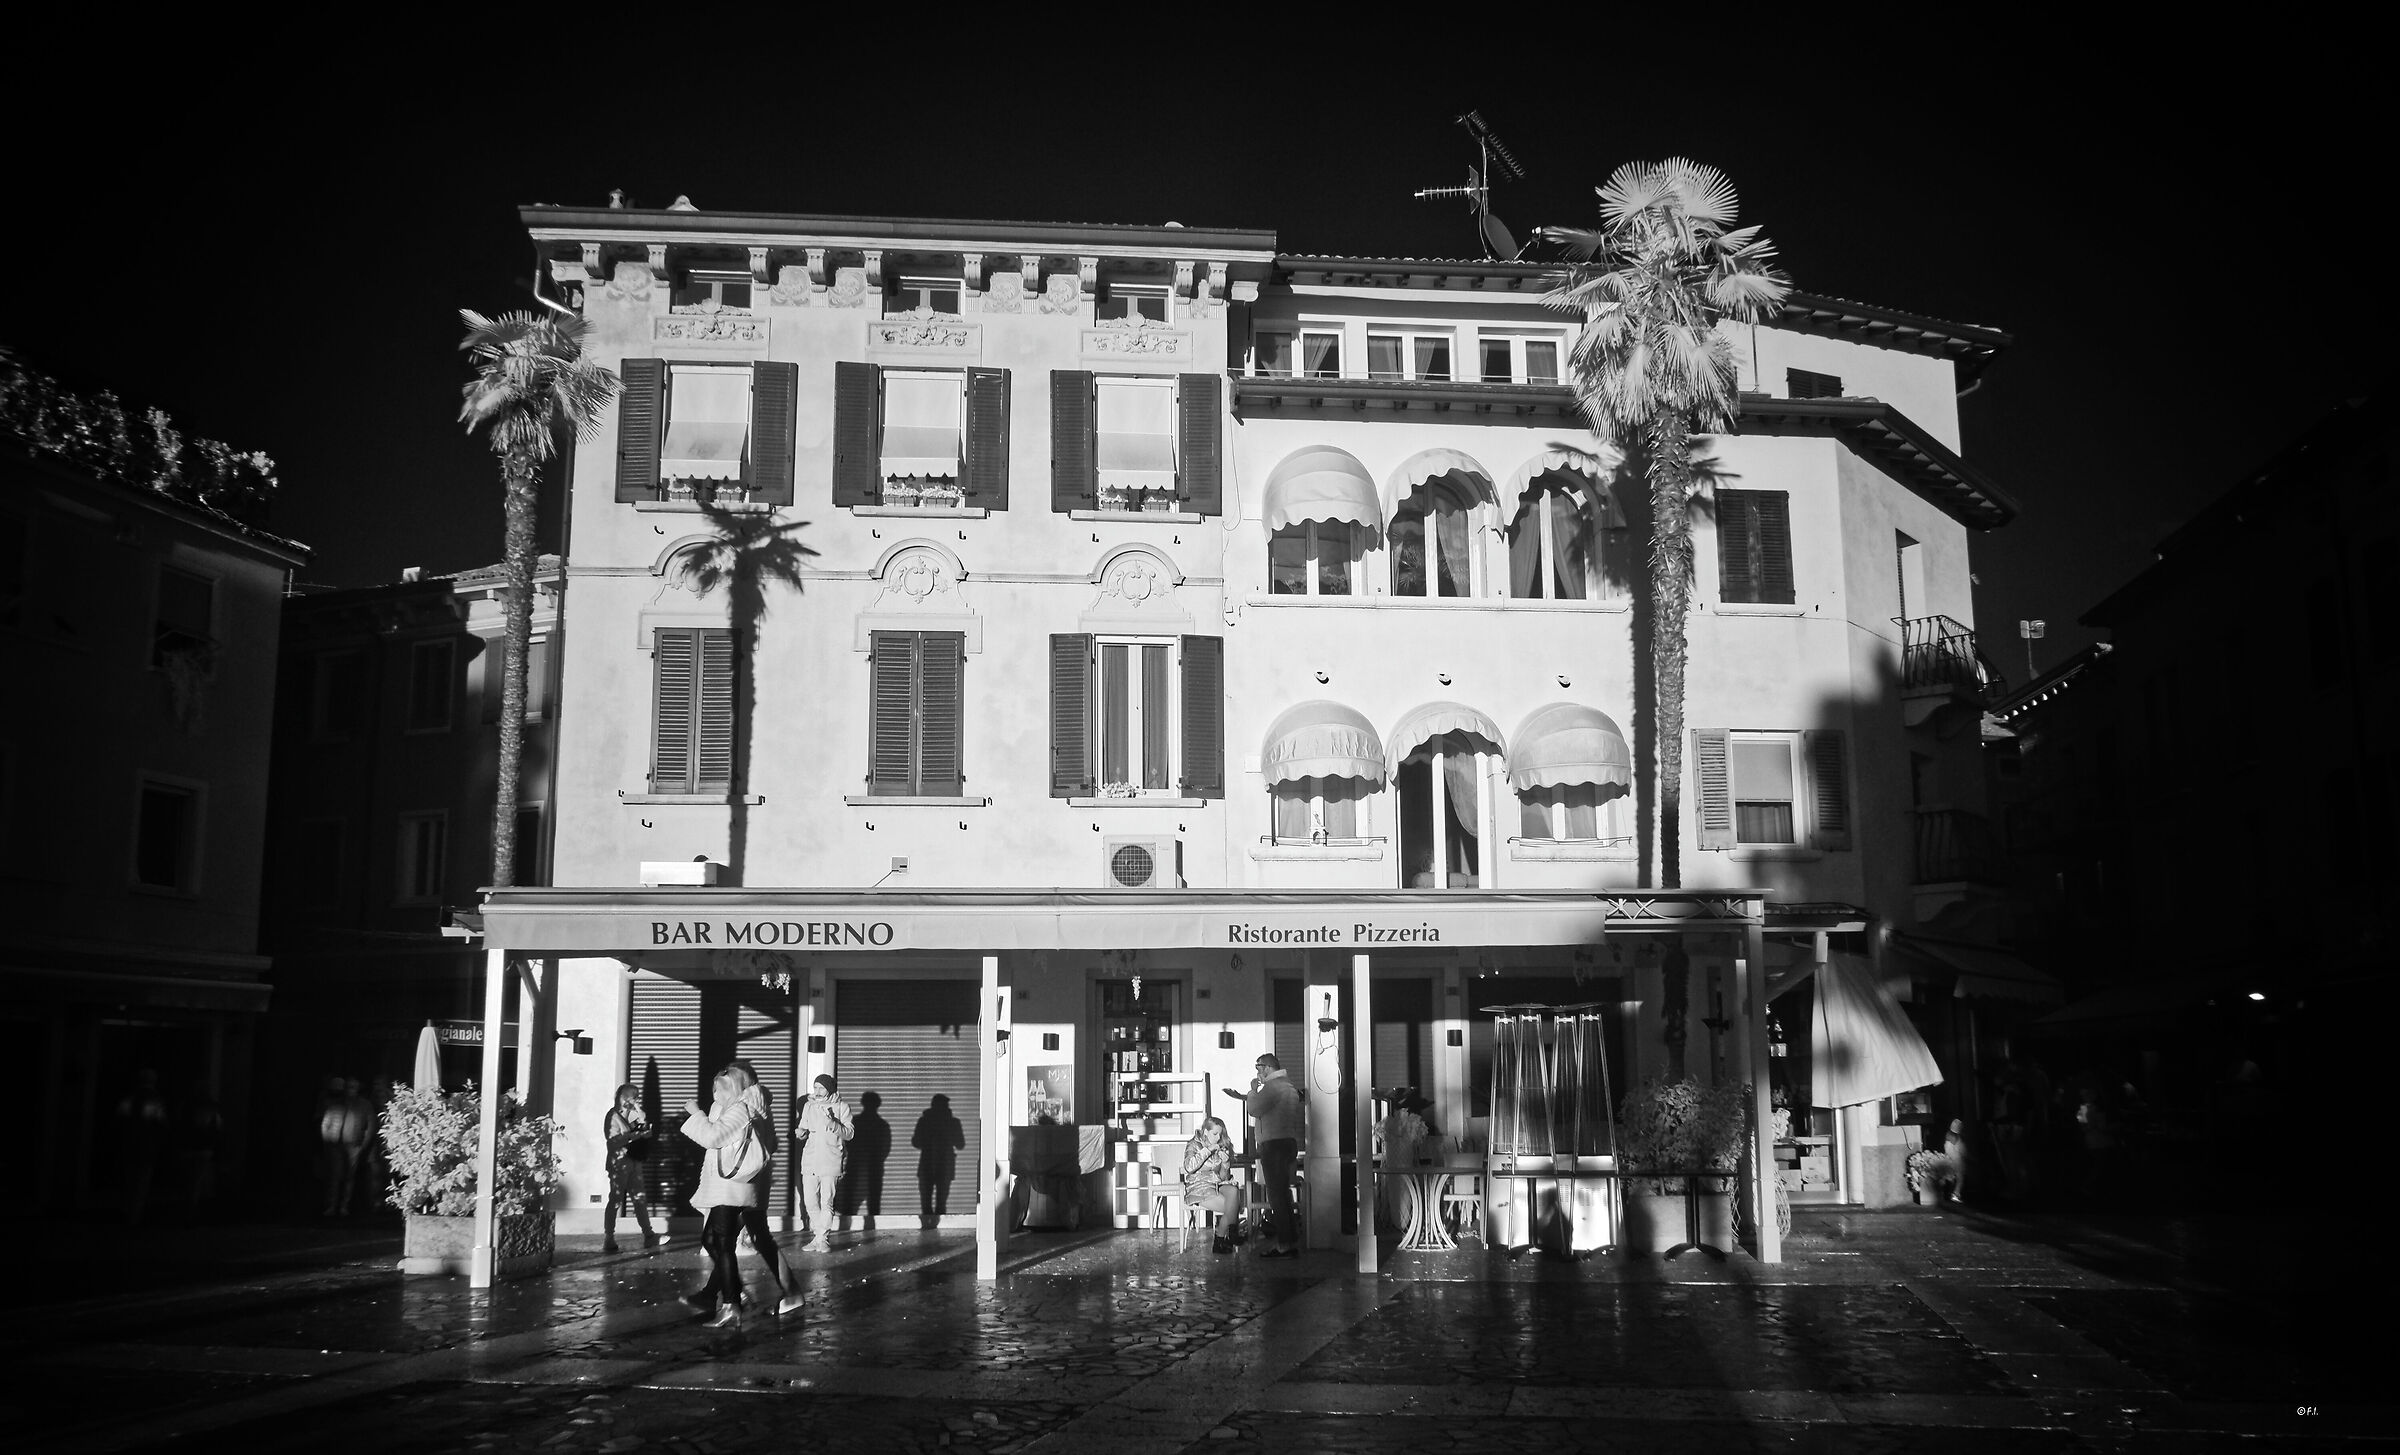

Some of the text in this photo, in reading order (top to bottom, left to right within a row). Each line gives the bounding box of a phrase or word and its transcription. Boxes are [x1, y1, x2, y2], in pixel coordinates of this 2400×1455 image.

[651, 921, 895, 947] BAR MODERNO
[1228, 922, 1441, 944] Ristorante Pizzeria
[440, 1023, 484, 1043] gianale
